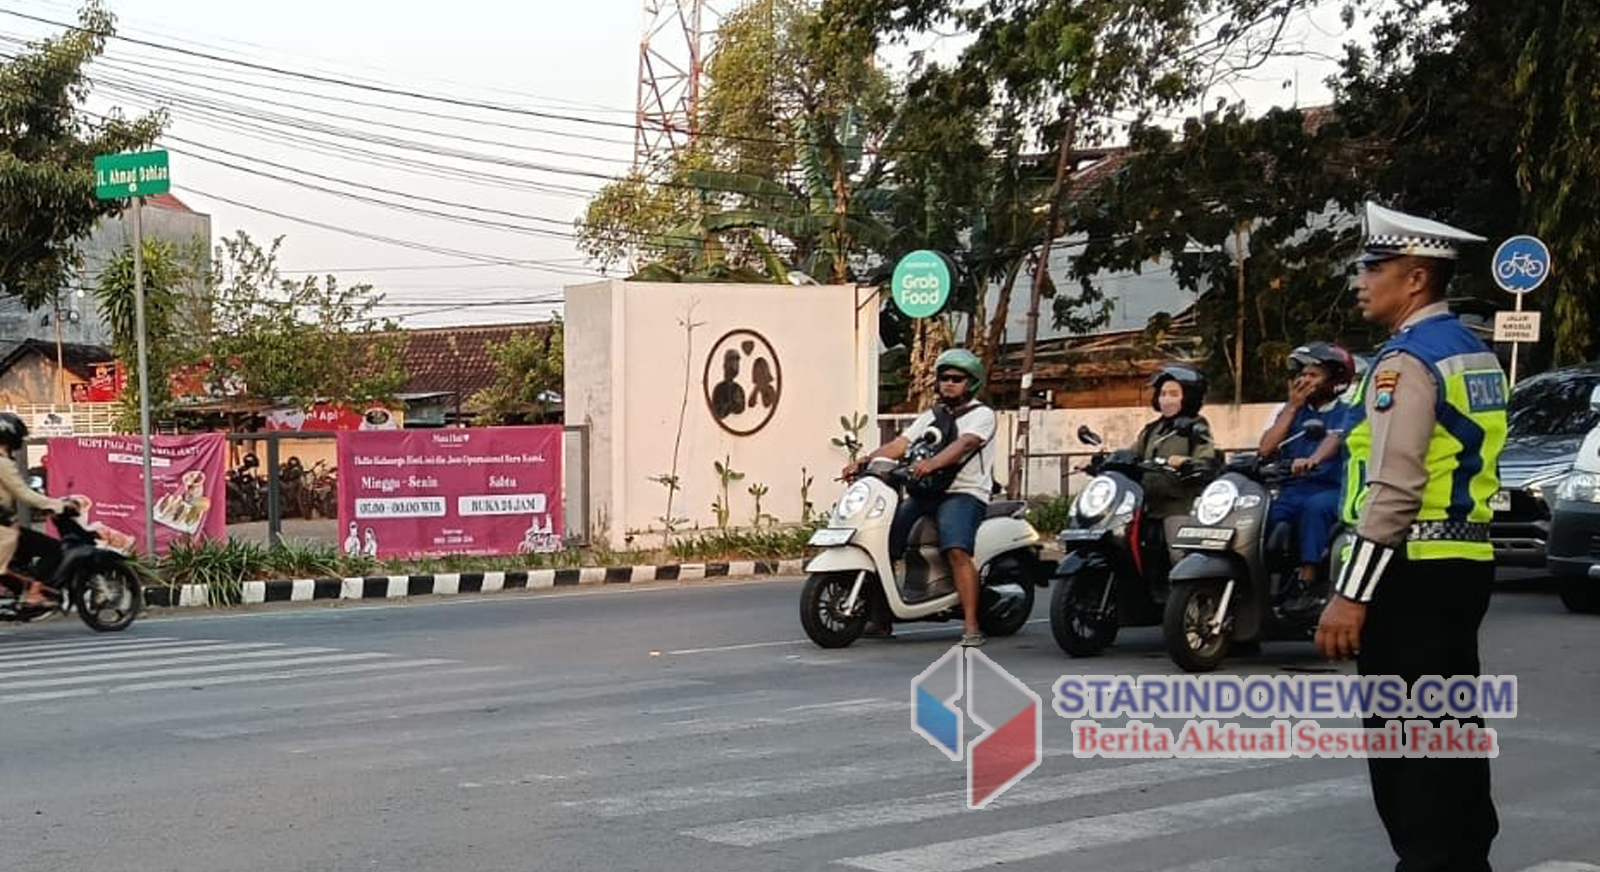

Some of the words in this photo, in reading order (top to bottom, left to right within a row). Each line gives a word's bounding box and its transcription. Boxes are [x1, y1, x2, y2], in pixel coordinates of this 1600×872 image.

[110, 168, 137, 184] Ahmad
[139, 166, 167, 182] Dahlan
[903, 275, 938, 289] Grab
[902, 290, 939, 304] Food
[362, 477, 400, 492] Minggu
[408, 476, 438, 488] Senin
[489, 475, 517, 488] Sabtu
[421, 501, 442, 512] WIB
[472, 499, 500, 511] BUKA
[513, 498, 535, 511] JAM
